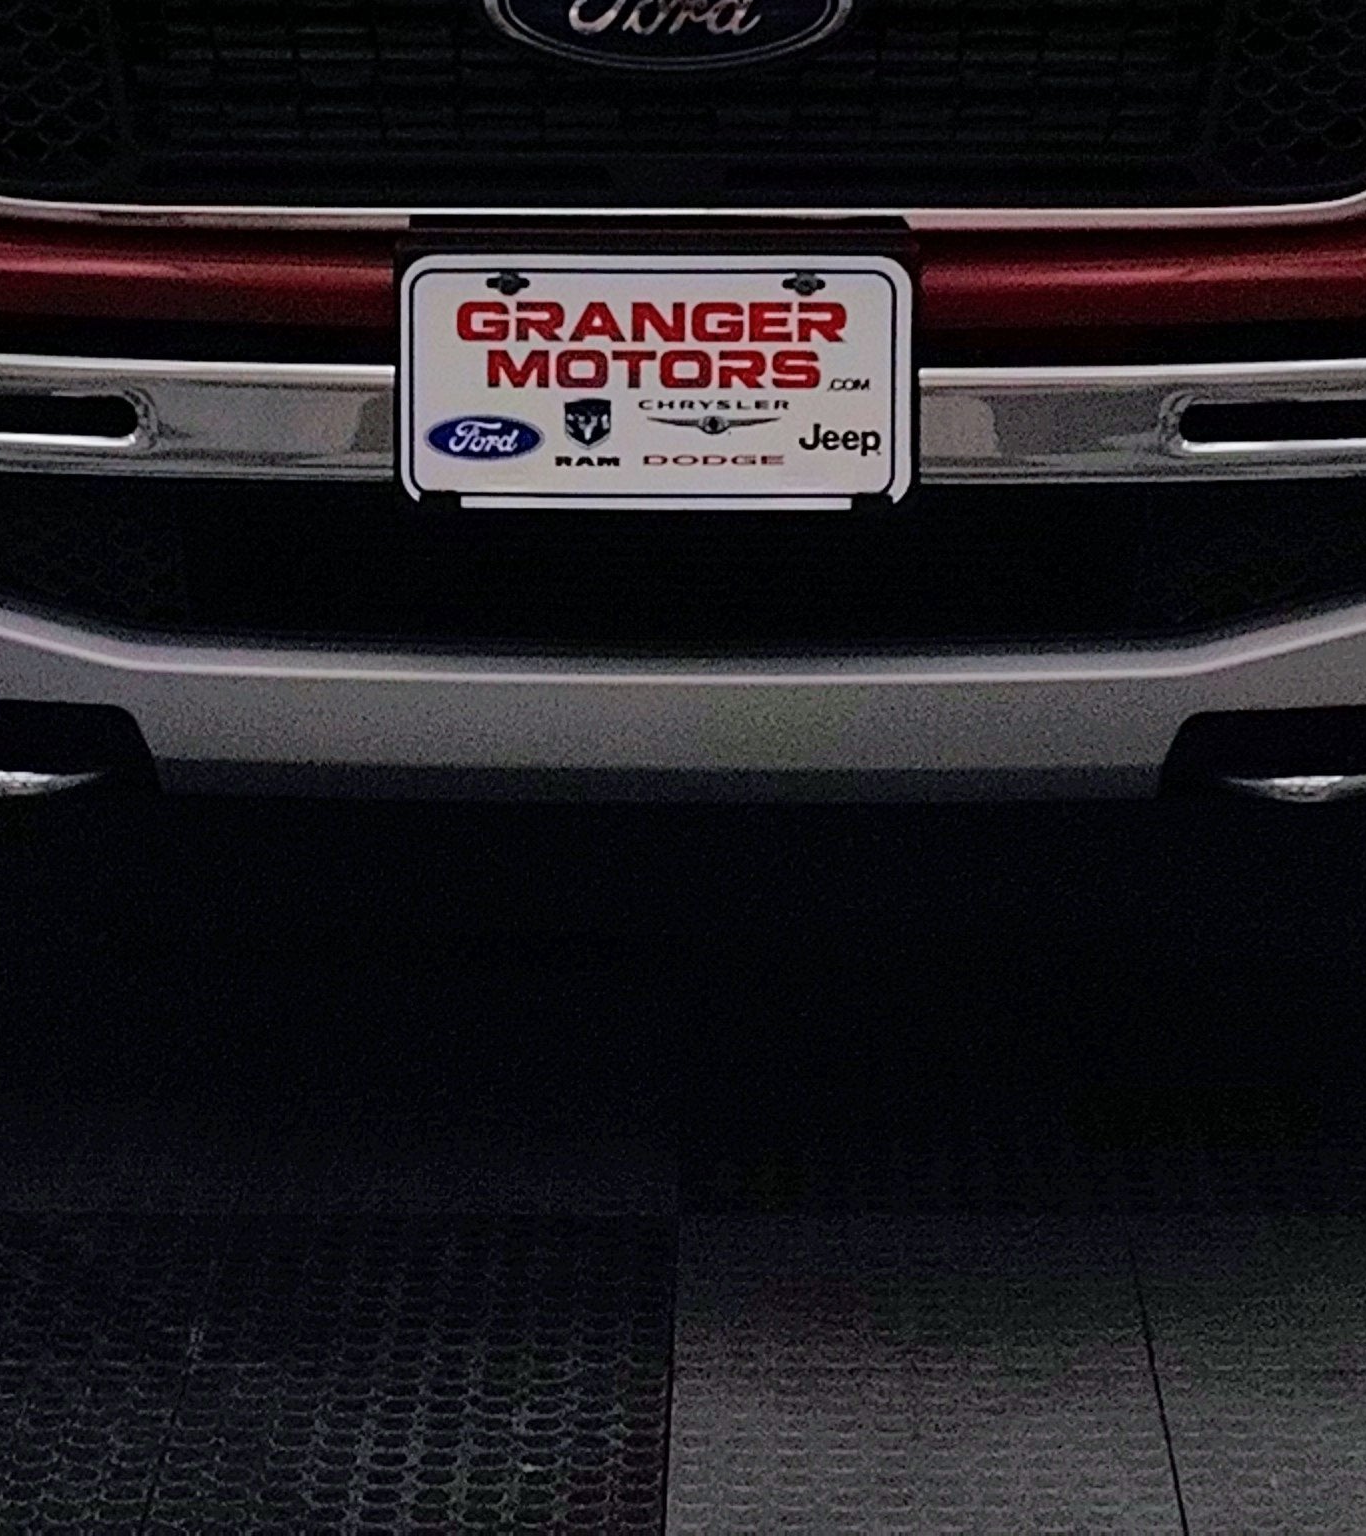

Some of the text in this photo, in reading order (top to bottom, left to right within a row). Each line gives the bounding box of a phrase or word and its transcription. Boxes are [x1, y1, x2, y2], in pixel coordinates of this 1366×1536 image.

[457, 301, 847, 343] GRANGER
[487, 349, 821, 390] MOTORS
[638, 399, 790, 411] CHRYSLER
[447, 420, 519, 454] Ford
[798, 423, 882, 457] Jeep
[555, 455, 621, 467] RAM
[643, 454, 785, 466] DODGE
